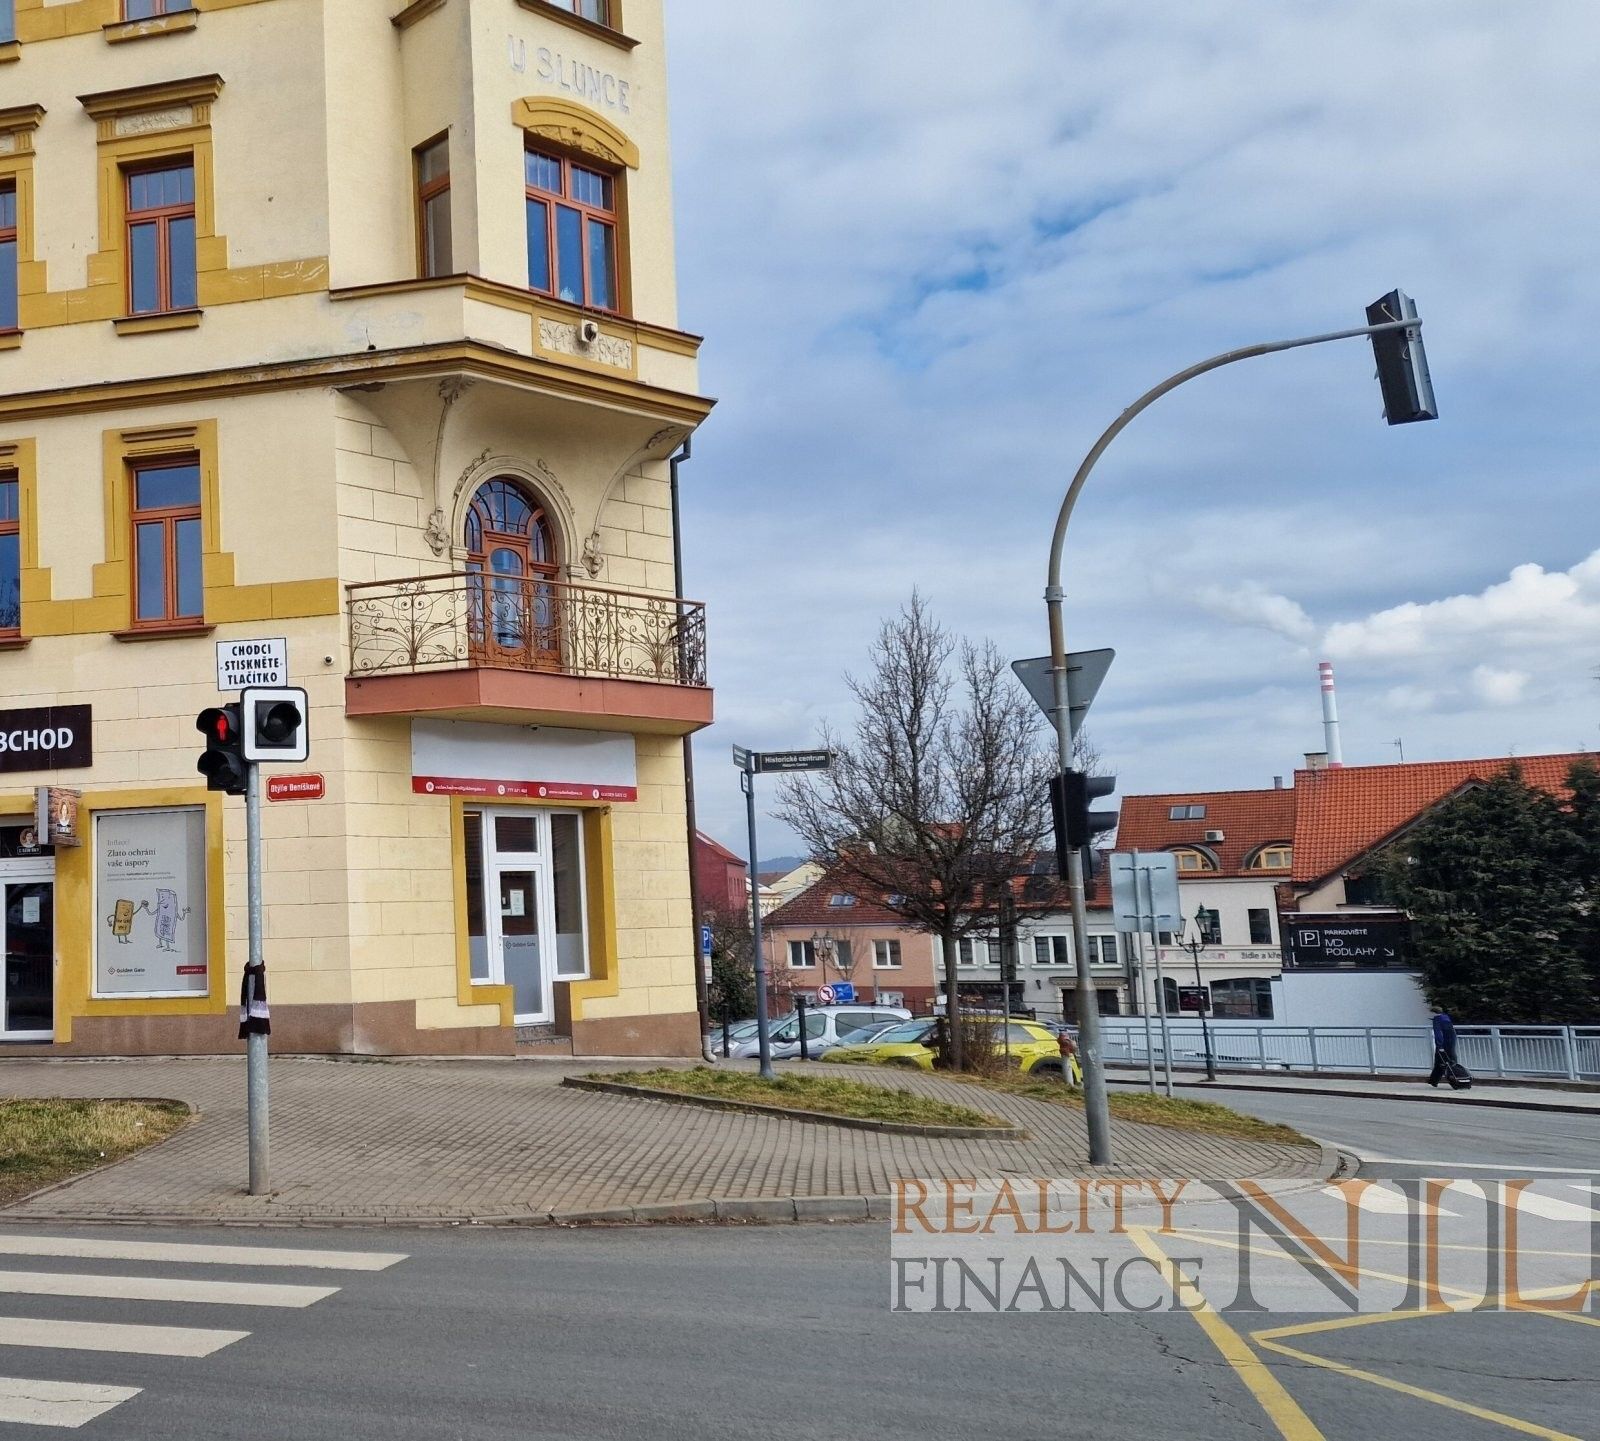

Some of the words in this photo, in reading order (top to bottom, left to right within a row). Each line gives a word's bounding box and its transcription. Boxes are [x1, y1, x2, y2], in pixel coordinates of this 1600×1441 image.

[508, 34, 525, 73] U
[537, 47, 630, 114] SLUNCE
[232, 644, 271, 656] CHODCI
[225, 656, 279, 671] STISKNĚTE
[228, 671, 277, 685] TLAČÍTKO
[765, 755, 797, 764] Historické
[107, 849, 127, 857] Zlato
[128, 847, 156, 856] ochrání
[107, 859, 123, 867] vaše
[124, 859, 150, 868] úspory
[1304, 932, 1316, 945] P
[1325, 939, 1344, 947] MD
[1326, 947, 1377, 956] PODLAHY
